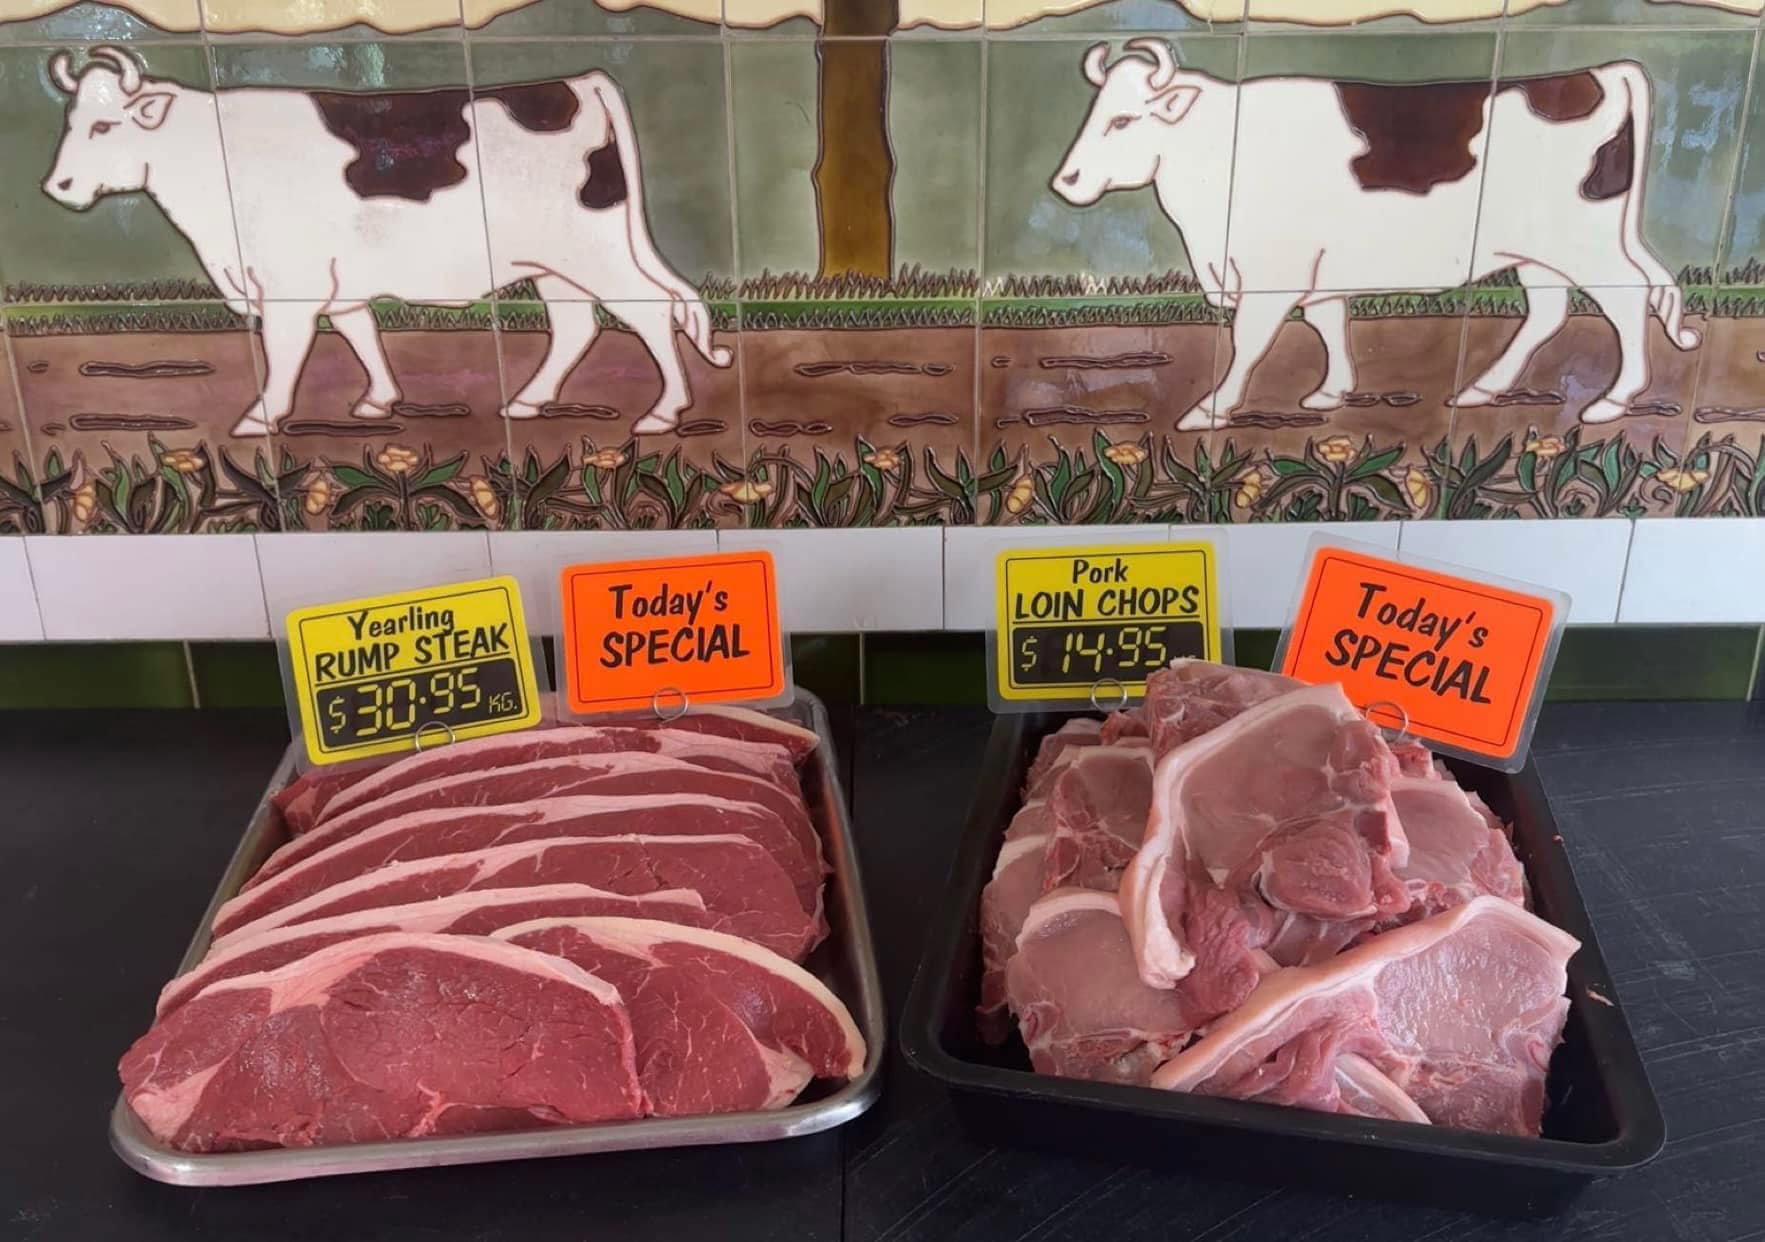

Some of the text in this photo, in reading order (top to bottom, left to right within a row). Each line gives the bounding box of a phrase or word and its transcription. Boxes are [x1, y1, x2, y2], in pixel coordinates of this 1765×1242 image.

[1072, 557, 1128, 584] Pork
[347, 605, 455, 641] Yearling
[608, 580, 729, 626] Today's
[1015, 584, 1200, 620] LOIN CHOPS
[1359, 582, 1489, 652] Today's
[314, 622, 510, 683] RUMP STEAK
[599, 623, 751, 669] SPECIAL
[1324, 628, 1492, 705] SPECIAL
